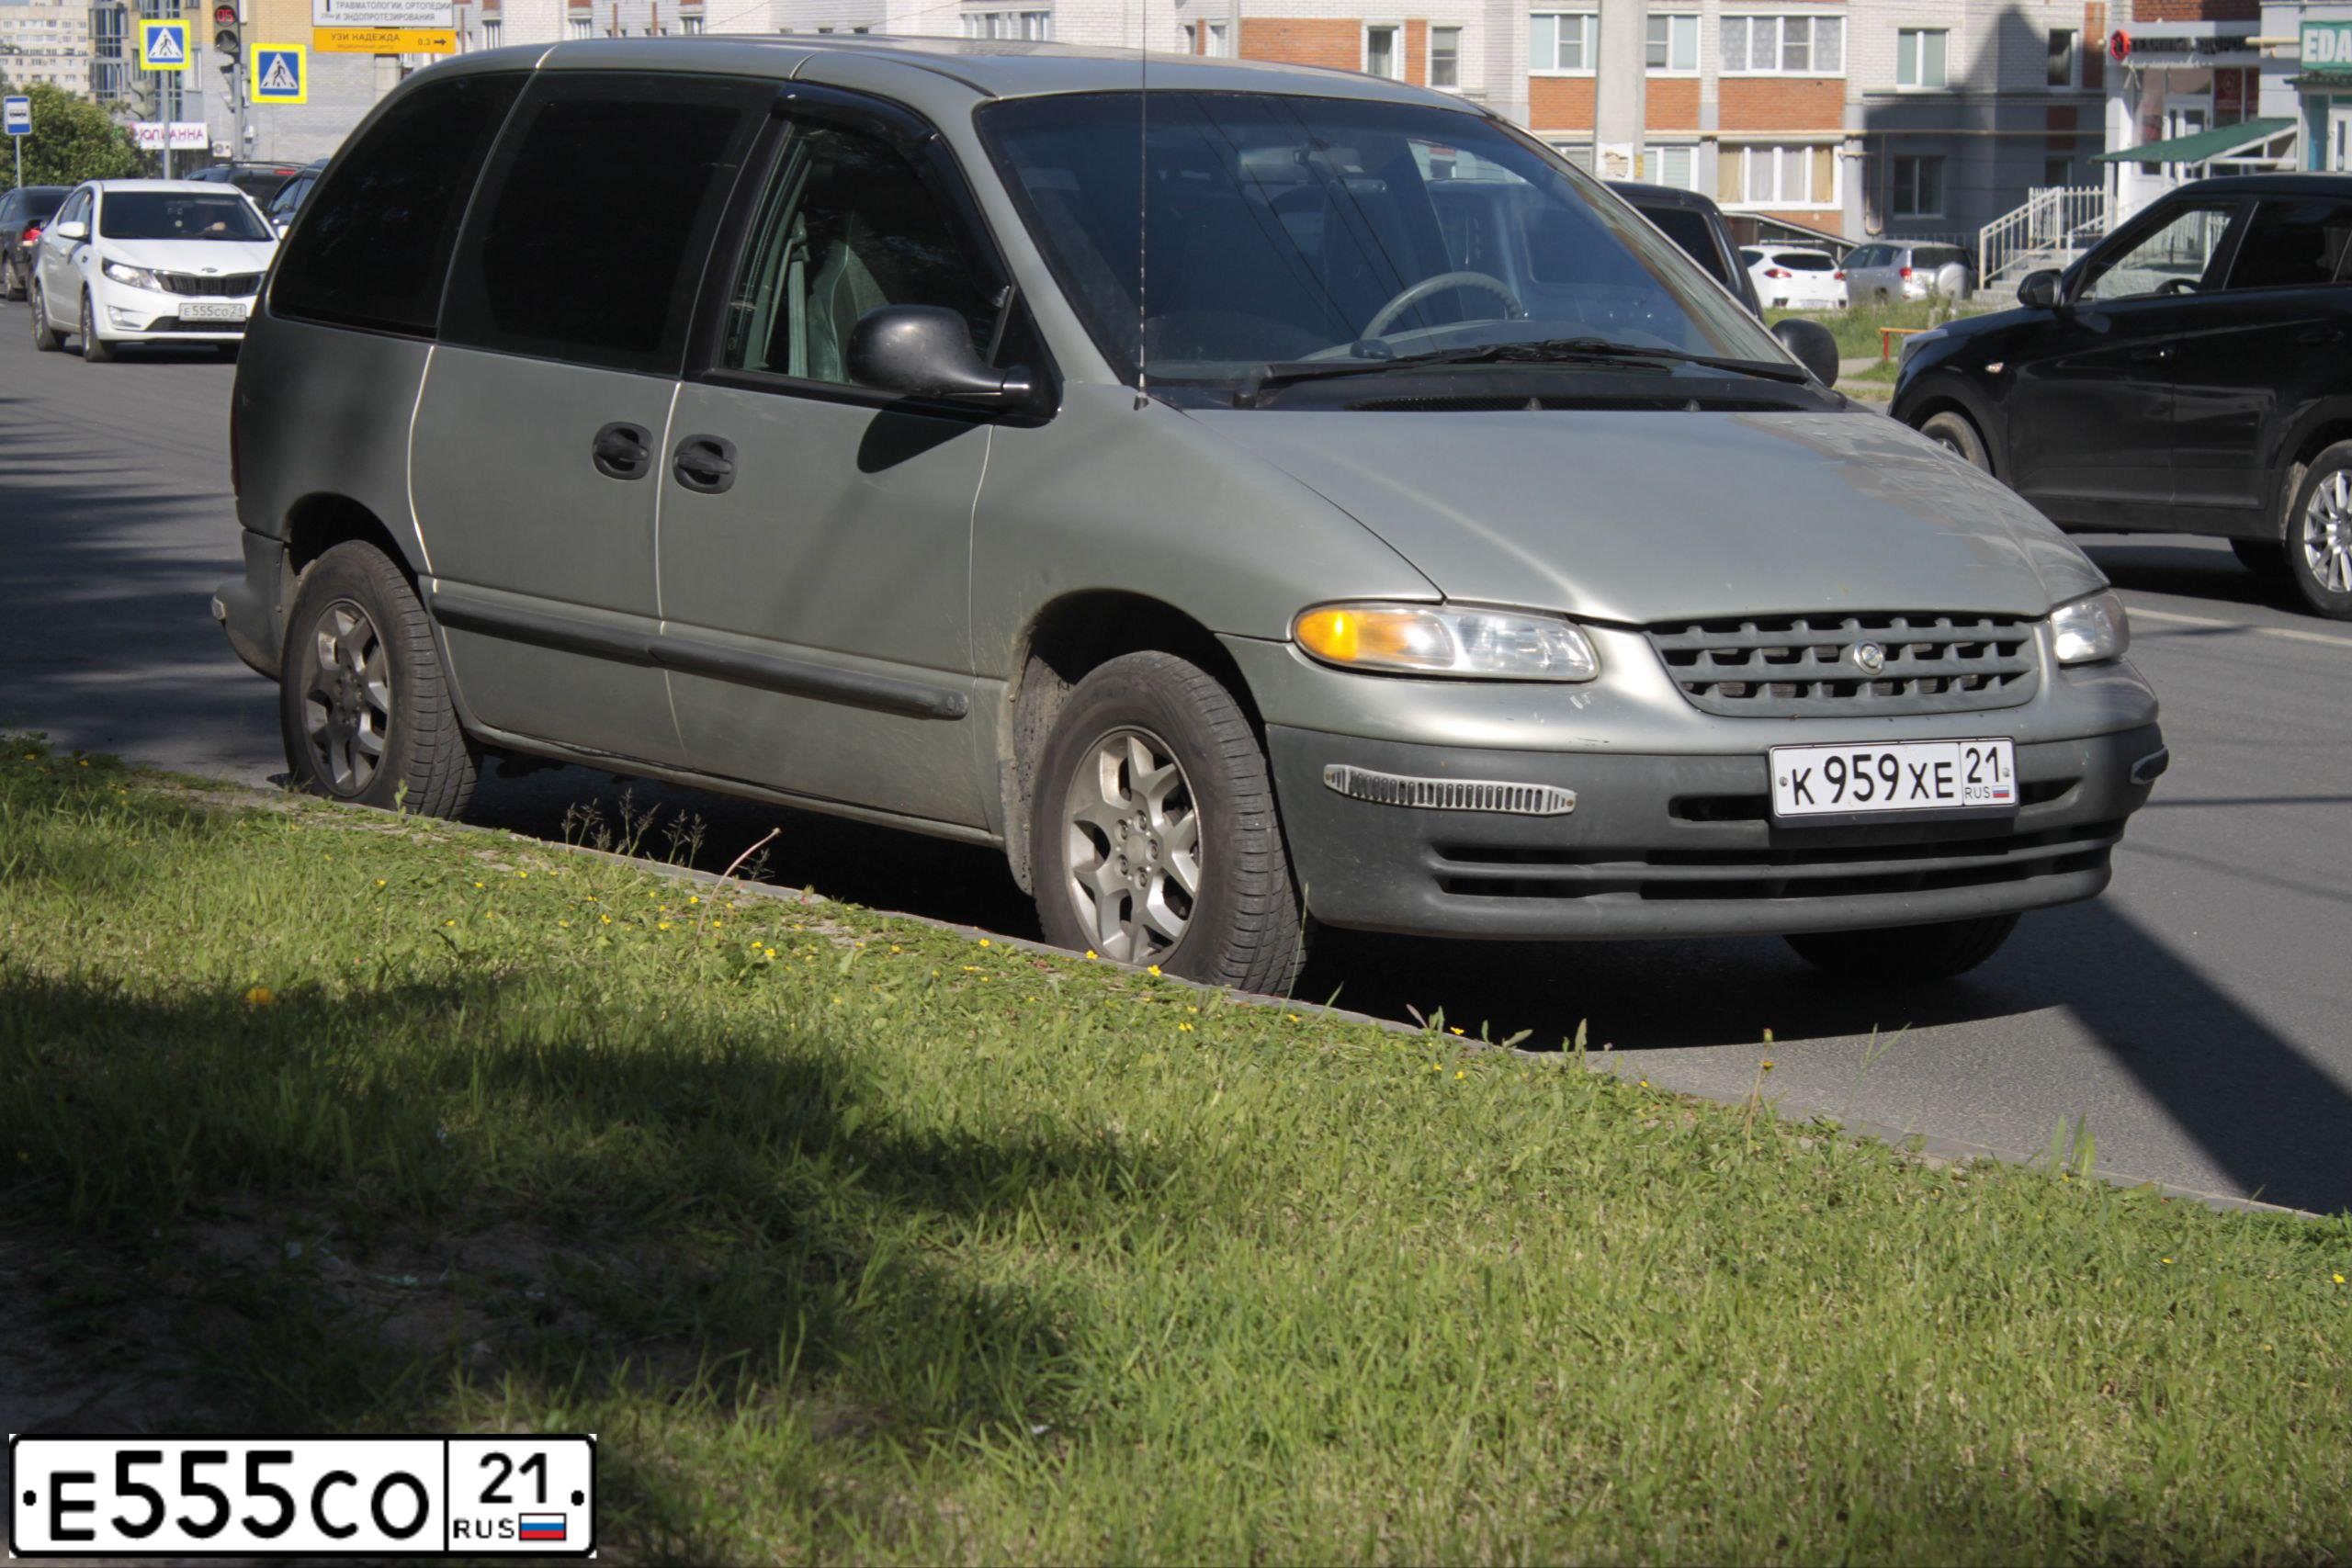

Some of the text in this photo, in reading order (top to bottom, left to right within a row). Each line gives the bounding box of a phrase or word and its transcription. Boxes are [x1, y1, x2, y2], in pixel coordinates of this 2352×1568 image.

[405, 1, 451, 10] ОРТОПЕДИИ
[344, 12, 435, 21] ЭНДОПРОТЕЗИРОВАНИЯ
[331, 33, 401, 41] УЗИ НАДЕЖДА
[1965, 746, 2000, 784] 21
[1964, 786, 1991, 799] RUS
